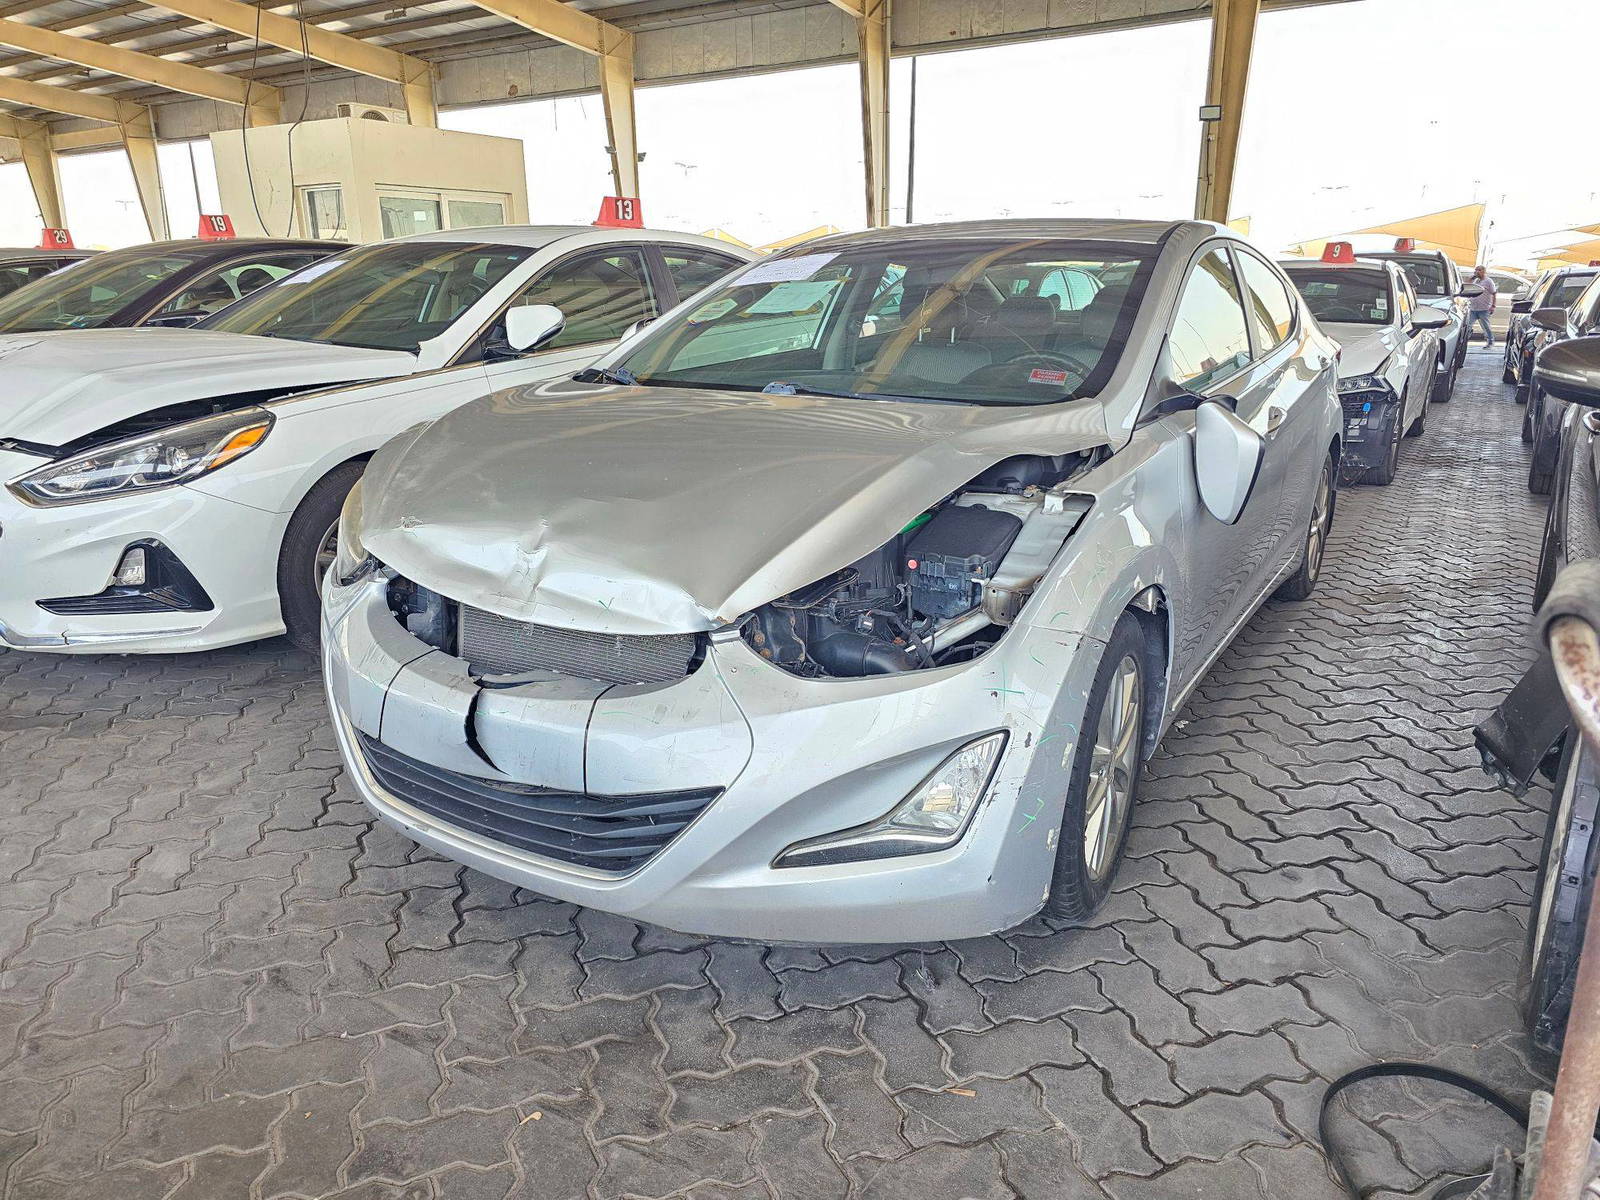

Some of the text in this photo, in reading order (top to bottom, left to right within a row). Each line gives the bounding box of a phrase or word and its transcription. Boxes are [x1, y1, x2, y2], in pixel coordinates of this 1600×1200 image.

[616, 199, 633, 220] 13
[210, 216, 227, 232] 19
[53, 230, 68, 244] 29
[1332, 244, 1341, 258] 9
